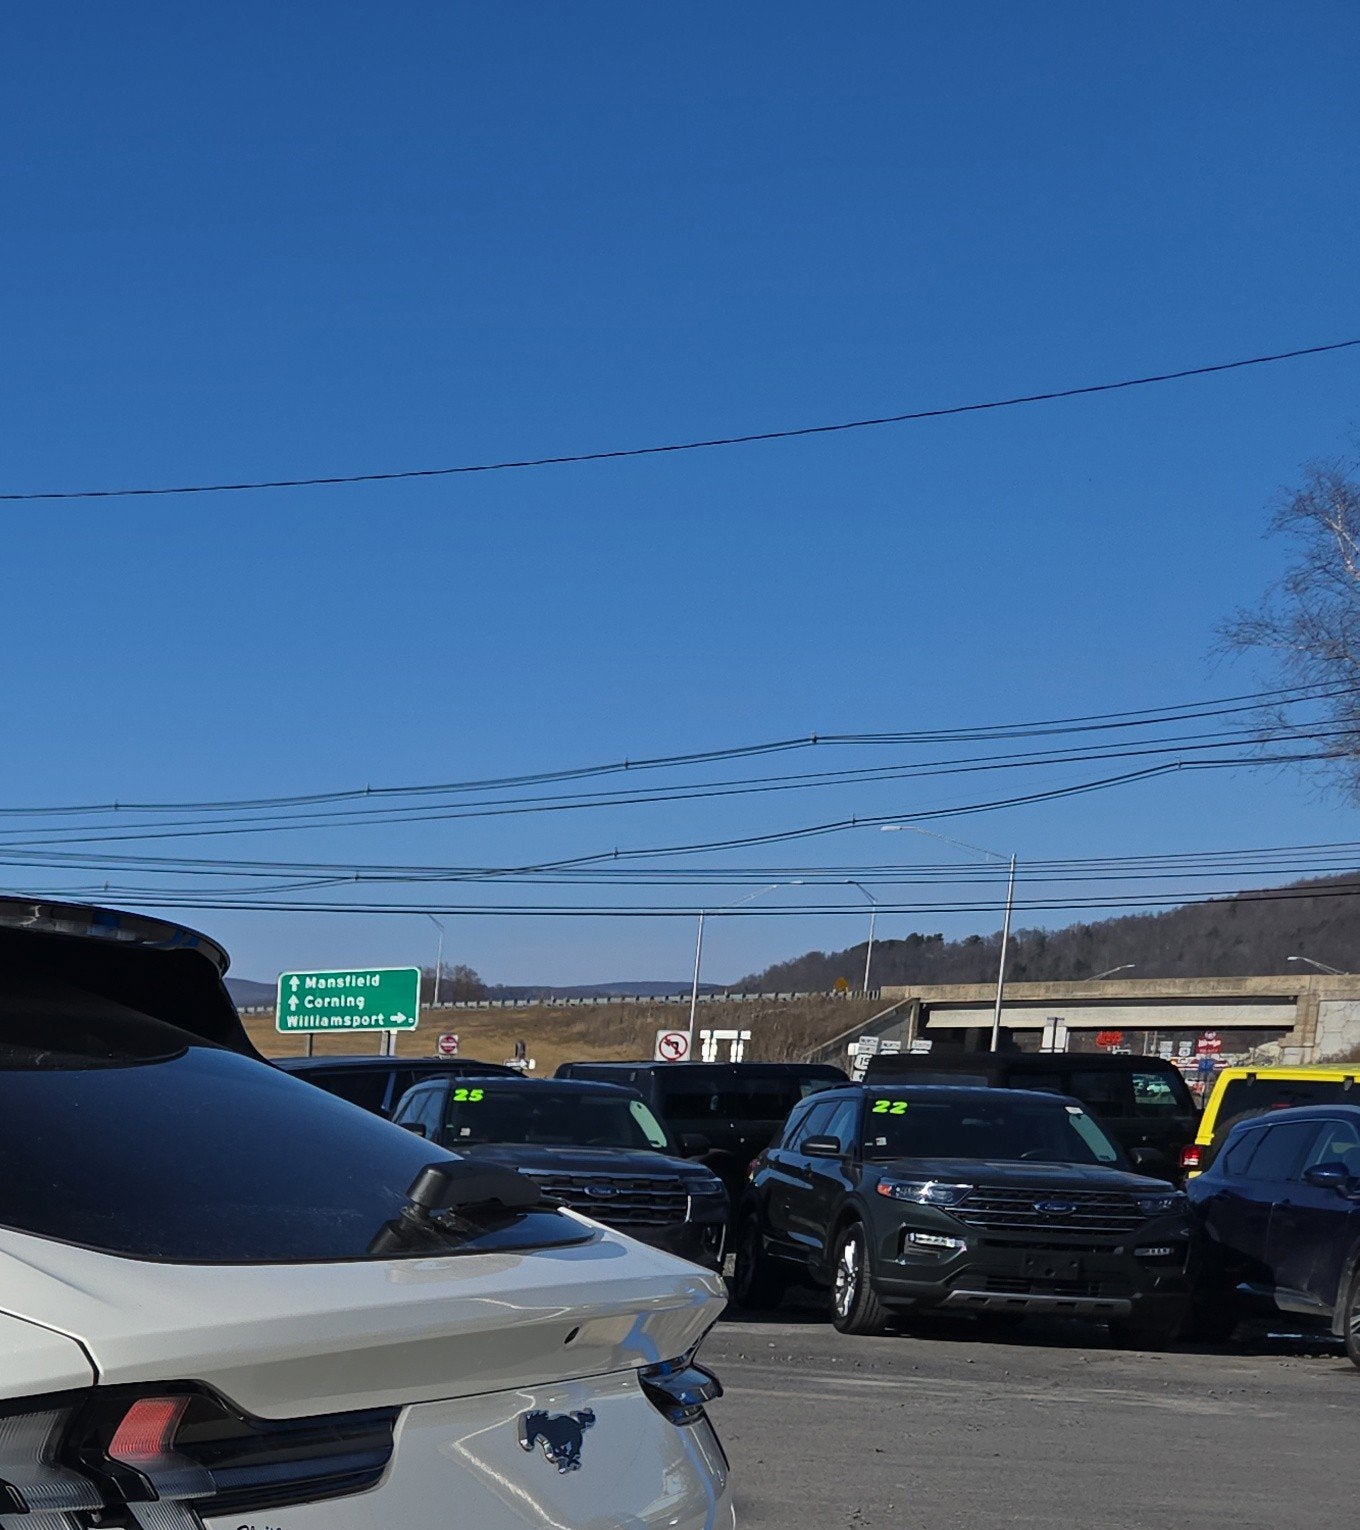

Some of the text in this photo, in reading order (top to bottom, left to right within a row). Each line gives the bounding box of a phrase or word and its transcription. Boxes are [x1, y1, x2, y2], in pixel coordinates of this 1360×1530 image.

[304, 974, 380, 990] Mansfield
[304, 994, 365, 1010] Corning
[286, 1013, 384, 1028] Williamsport
[453, 1088, 484, 1102] 25
[871, 1100, 908, 1115] 22
